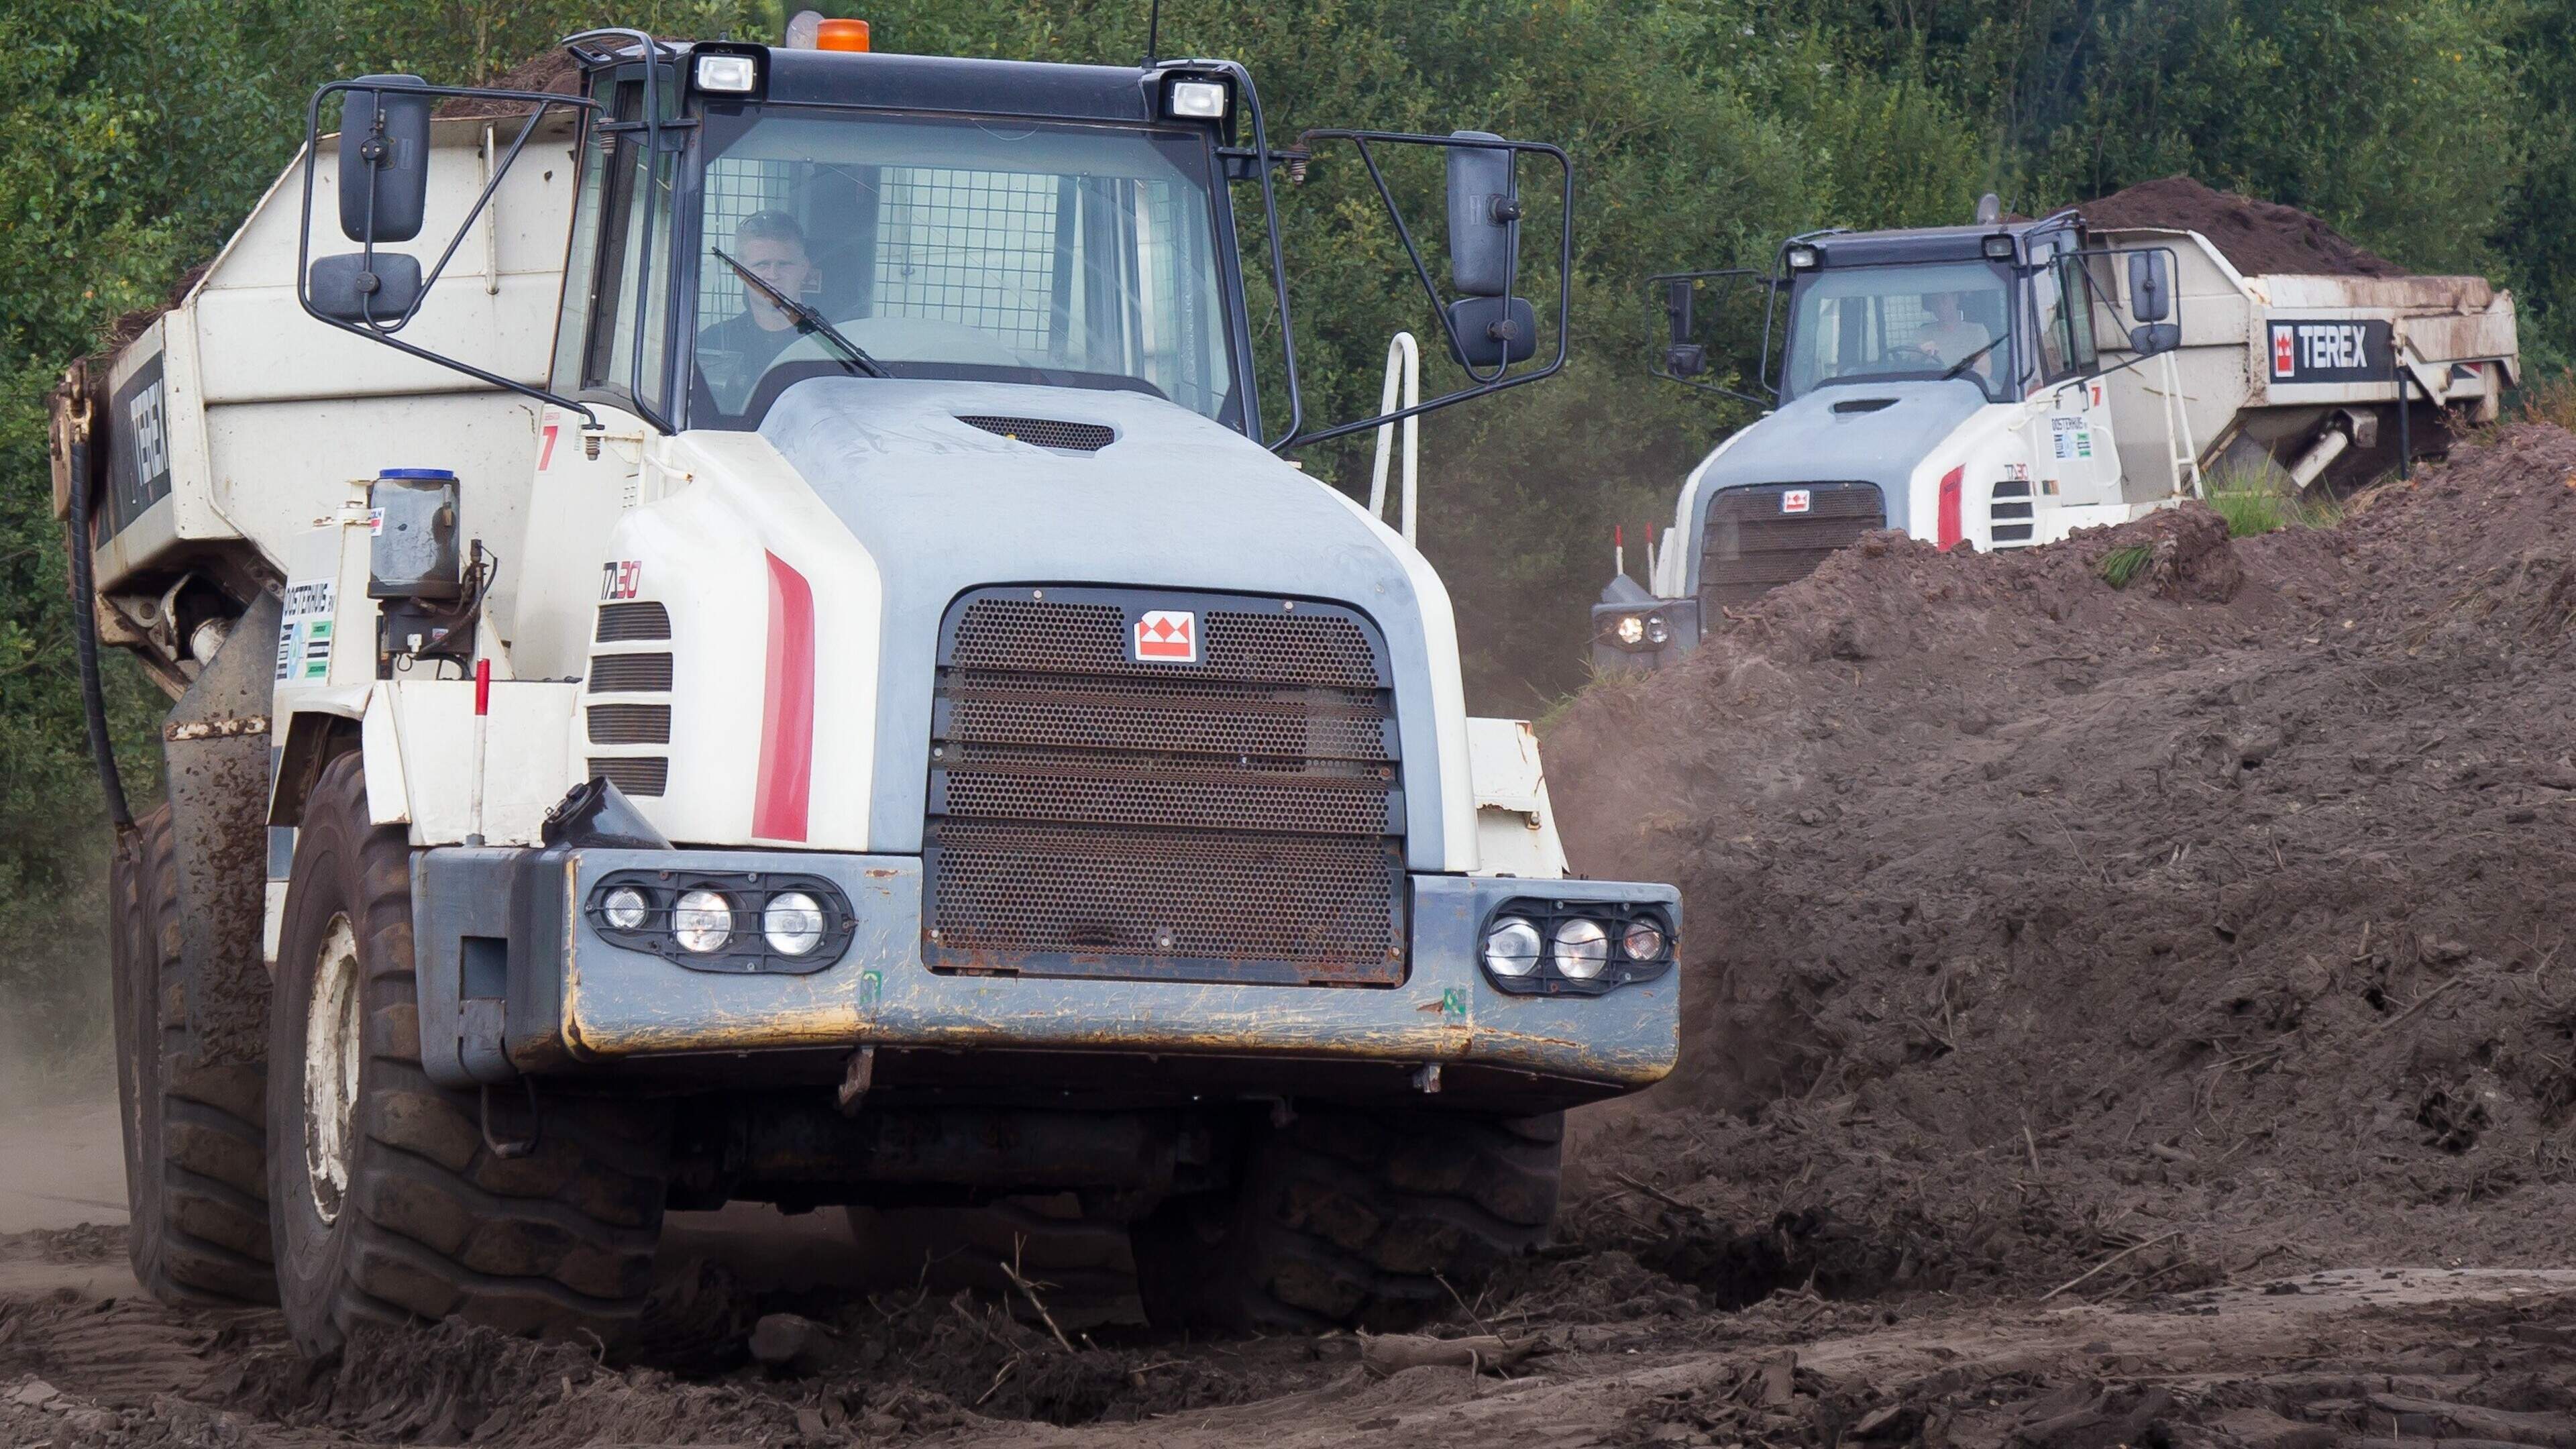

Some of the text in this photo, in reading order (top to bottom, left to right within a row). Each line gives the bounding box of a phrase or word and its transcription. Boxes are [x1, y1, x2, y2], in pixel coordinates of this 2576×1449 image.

[2298, 325, 2367, 368] TEREX
[2092, 387, 2101, 406] 7
[131, 378, 169, 486] TEREX
[539, 426, 558, 471] 7
[601, 561, 641, 599] TA30
